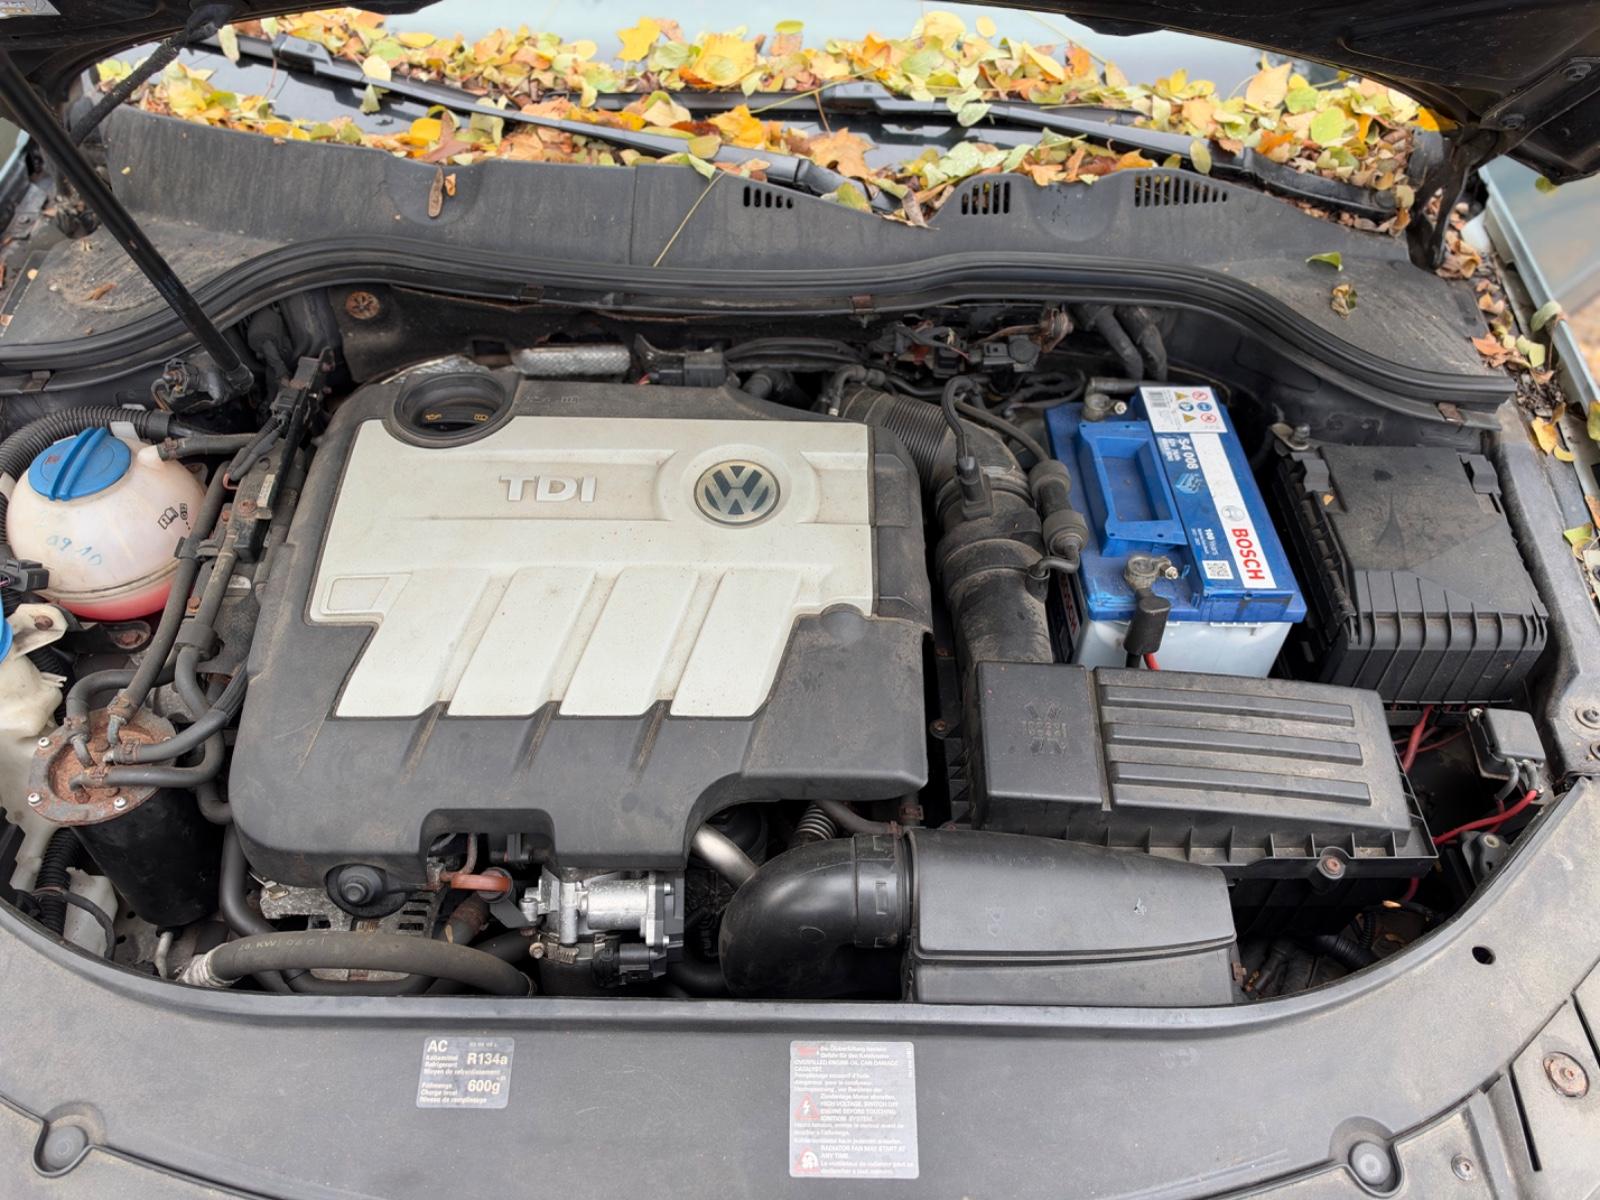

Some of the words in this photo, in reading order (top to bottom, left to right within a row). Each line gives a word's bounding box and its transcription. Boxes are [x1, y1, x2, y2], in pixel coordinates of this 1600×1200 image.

[1178, 438, 1192, 450] S4
[1183, 451, 1199, 469] 008
[499, 475, 597, 502] TDI
[1231, 528, 1266, 580] BOSCH
[427, 1040, 448, 1052] AC
[466, 1052, 508, 1065] R134a
[467, 1079, 501, 1094] 600g
